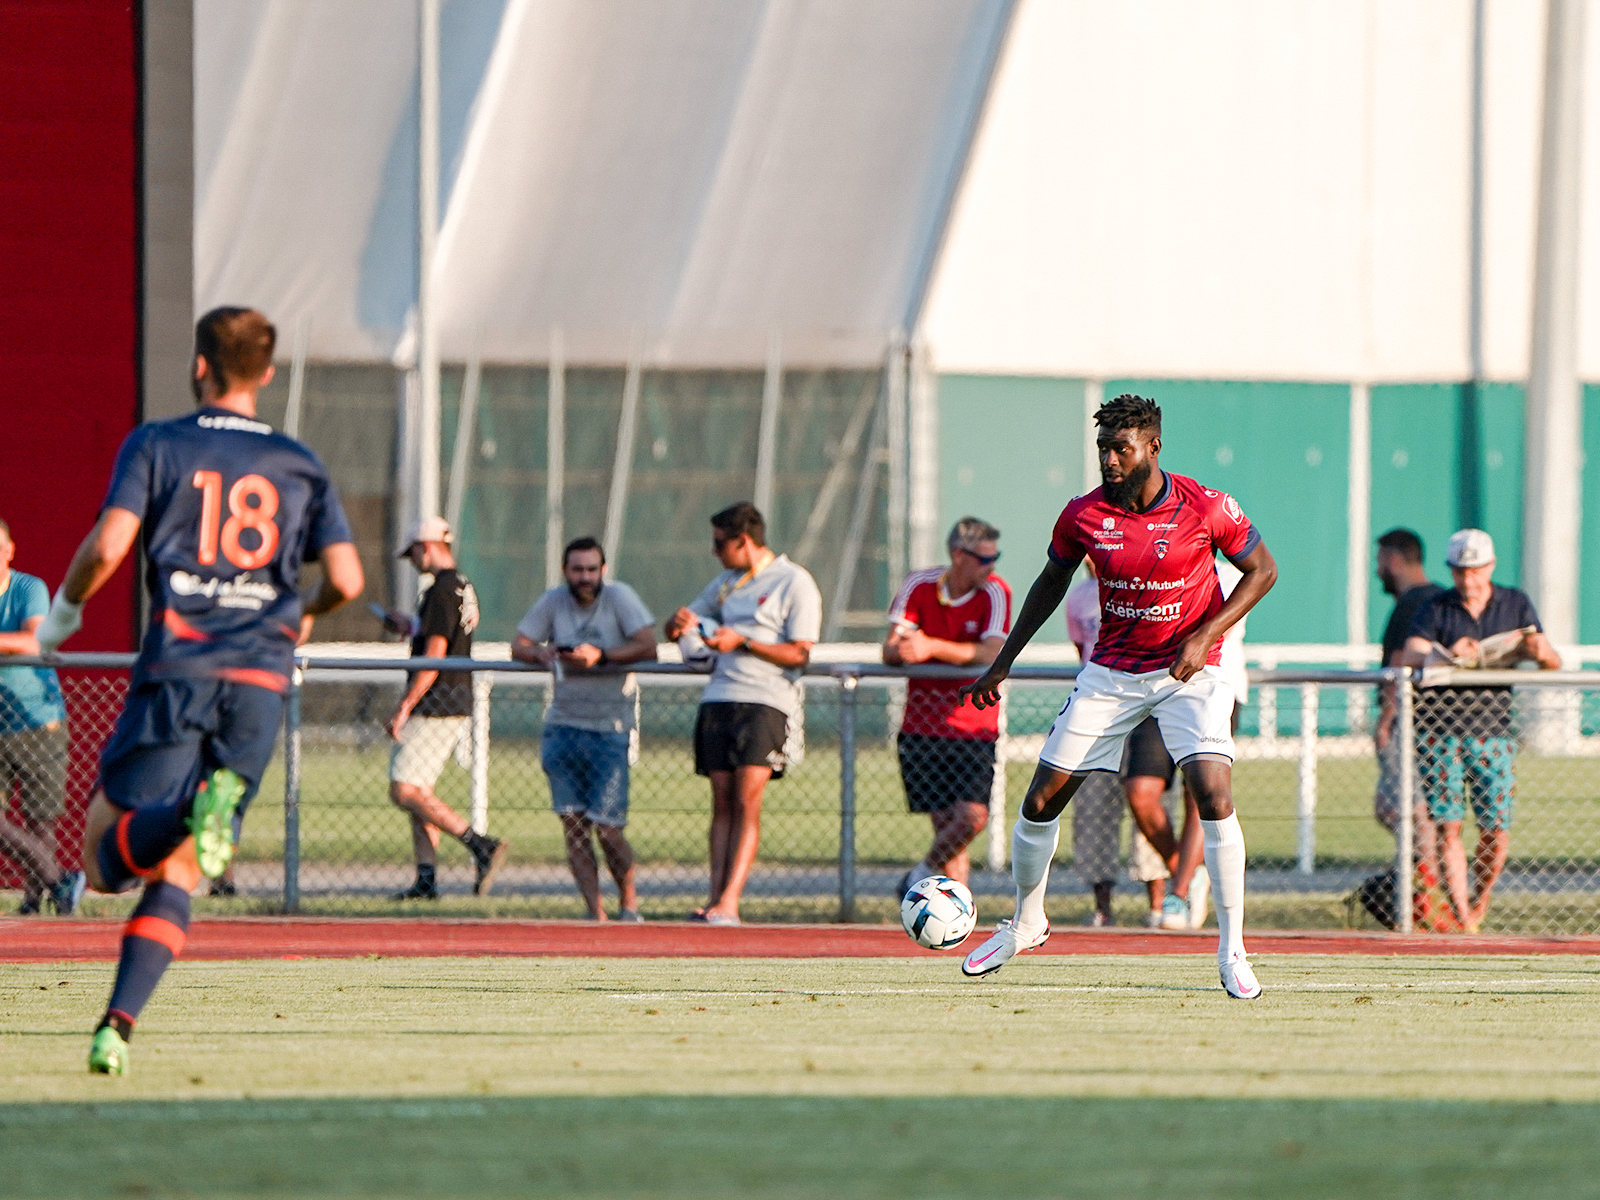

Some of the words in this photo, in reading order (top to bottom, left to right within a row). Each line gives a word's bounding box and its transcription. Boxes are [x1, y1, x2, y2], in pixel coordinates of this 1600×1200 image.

[193, 470, 280, 570] 18
[1094, 543, 1124, 551] uhlsport
[1146, 577, 1185, 590] Mutuel
